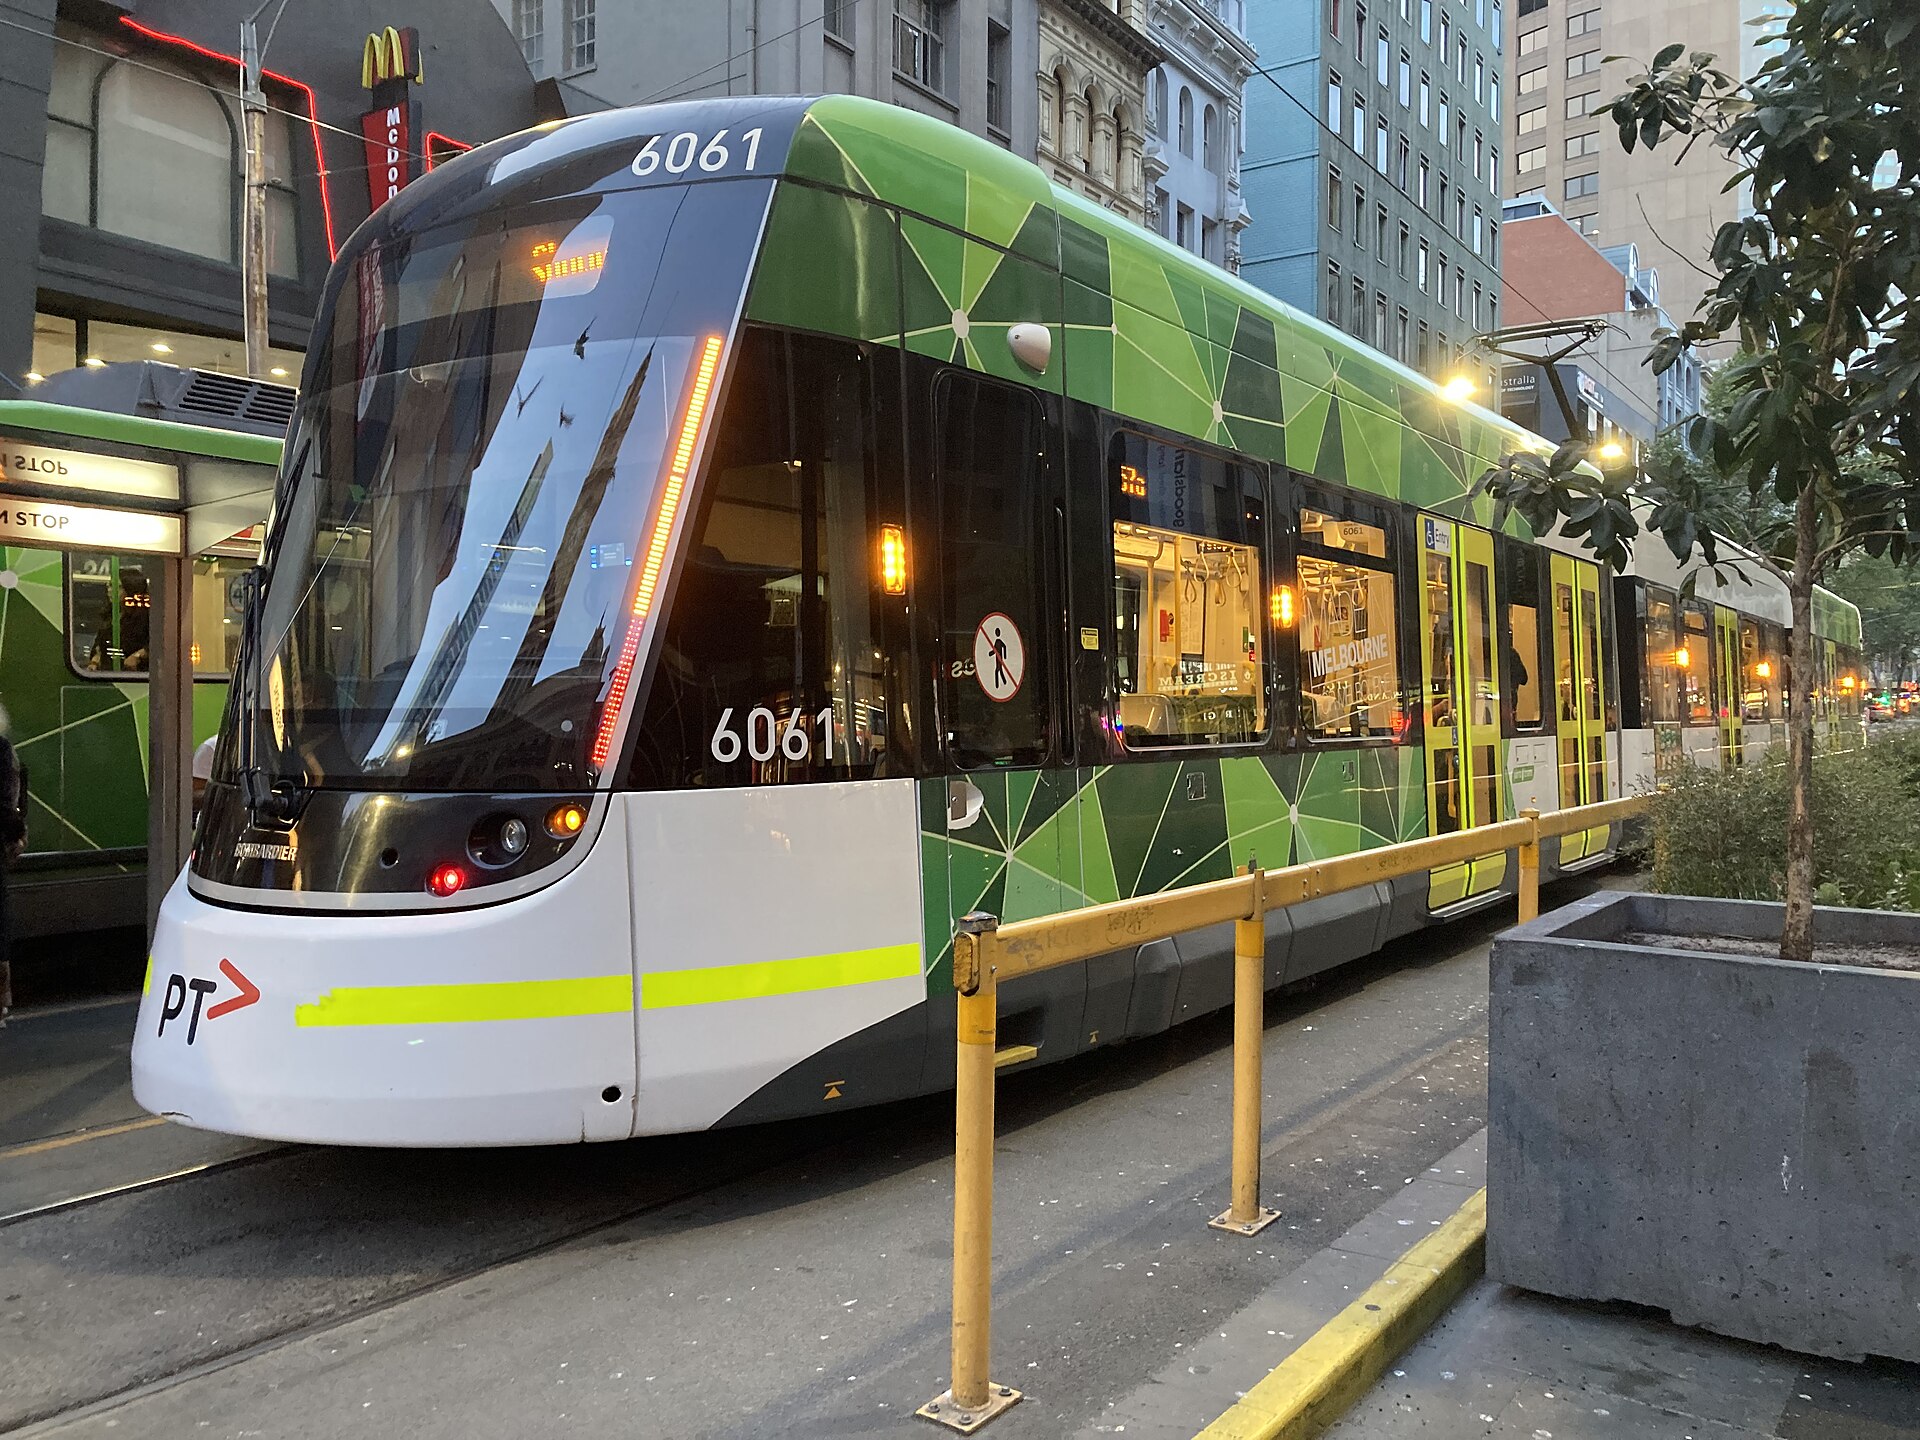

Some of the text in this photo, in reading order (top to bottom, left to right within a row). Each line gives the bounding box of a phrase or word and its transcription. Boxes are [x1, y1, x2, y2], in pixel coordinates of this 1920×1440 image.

[631, 127, 763, 177] 6061
[16, 511, 69, 530] STOP
[1343, 527, 1363, 536] 6061
[1435, 528, 1449, 549] Entry
[1312, 634, 1388, 678] MELBOURNE
[711, 707, 833, 763] 6061
[234, 843, 298, 860] BOMBARDIER
